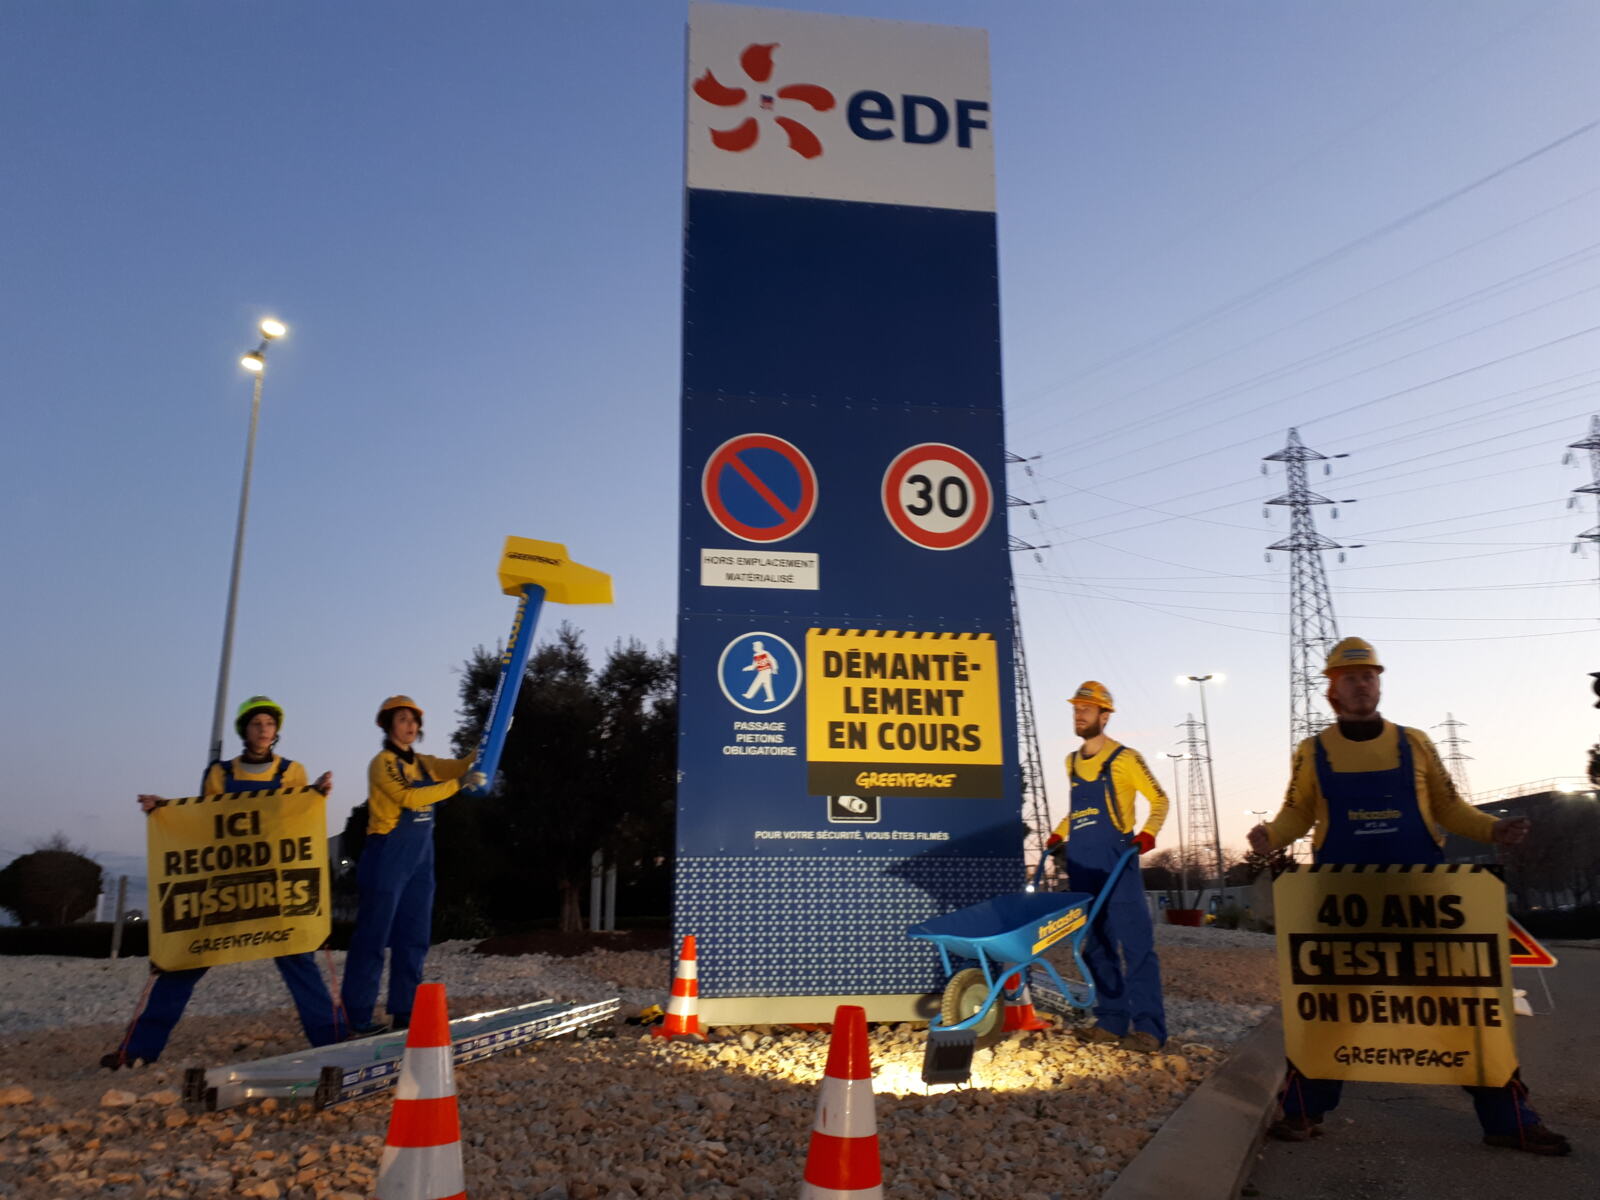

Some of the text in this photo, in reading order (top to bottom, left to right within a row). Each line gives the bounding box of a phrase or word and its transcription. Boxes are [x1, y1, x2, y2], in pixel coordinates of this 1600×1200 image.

[906, 474, 968, 518] 30
[704, 556, 816, 568] HORS EMPLACEMENT
[843, 687, 964, 717] LEMENT
[733, 722, 787, 731] PASSAGE
[736, 733, 785, 743] PIETONS
[828, 721, 982, 752] EN COURS
[722, 745, 797, 756] OBLIGATOIRE
[855, 772, 957, 789] GREENPEACE
[214, 811, 261, 839] ICI
[755, 831, 783, 839] POUR
[783, 831, 815, 839] VOTRE
[864, 832, 891, 840] VOUS
[164, 836, 313, 876] RECORD DE
[172, 880, 310, 921] FISSURES
[1317, 894, 1466, 929] 40 ANS
[188, 928, 295, 953] GREENPEACE
[1299, 941, 1493, 978] C'EST FINI
[1297, 990, 1503, 1027] ON DÉMONTE
[1334, 1046, 1470, 1068] GREENPEACE
